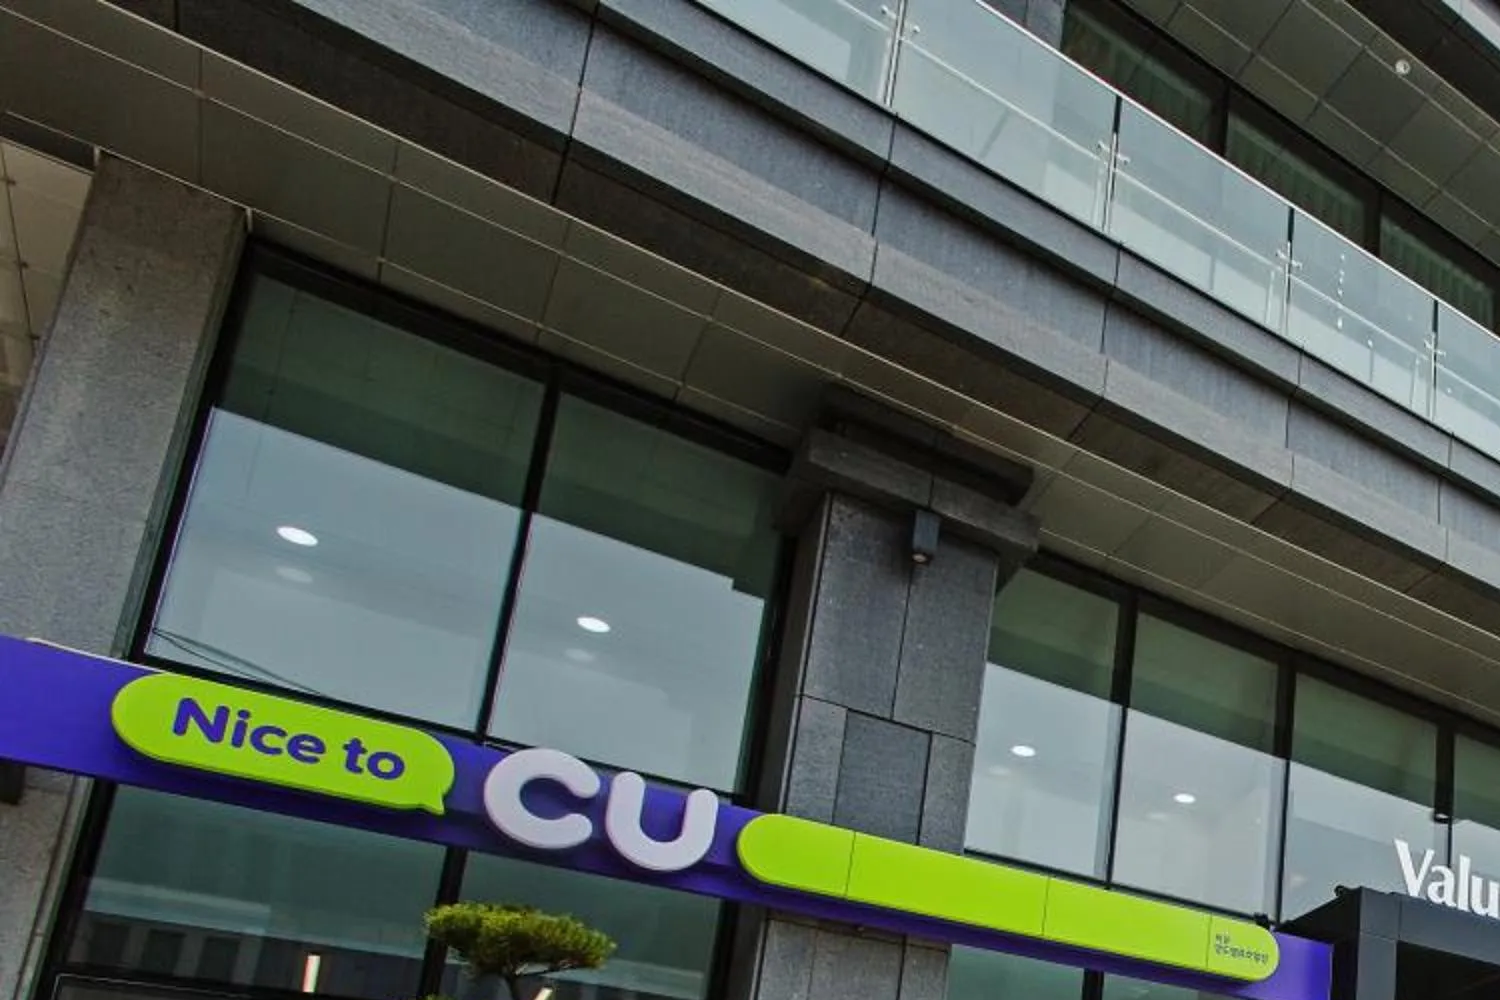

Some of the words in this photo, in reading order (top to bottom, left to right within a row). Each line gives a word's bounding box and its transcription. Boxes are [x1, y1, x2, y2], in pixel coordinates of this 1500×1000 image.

[172, 697, 326, 765] Nice
[343, 738, 405, 781] to
[484, 747, 719, 872] CU
